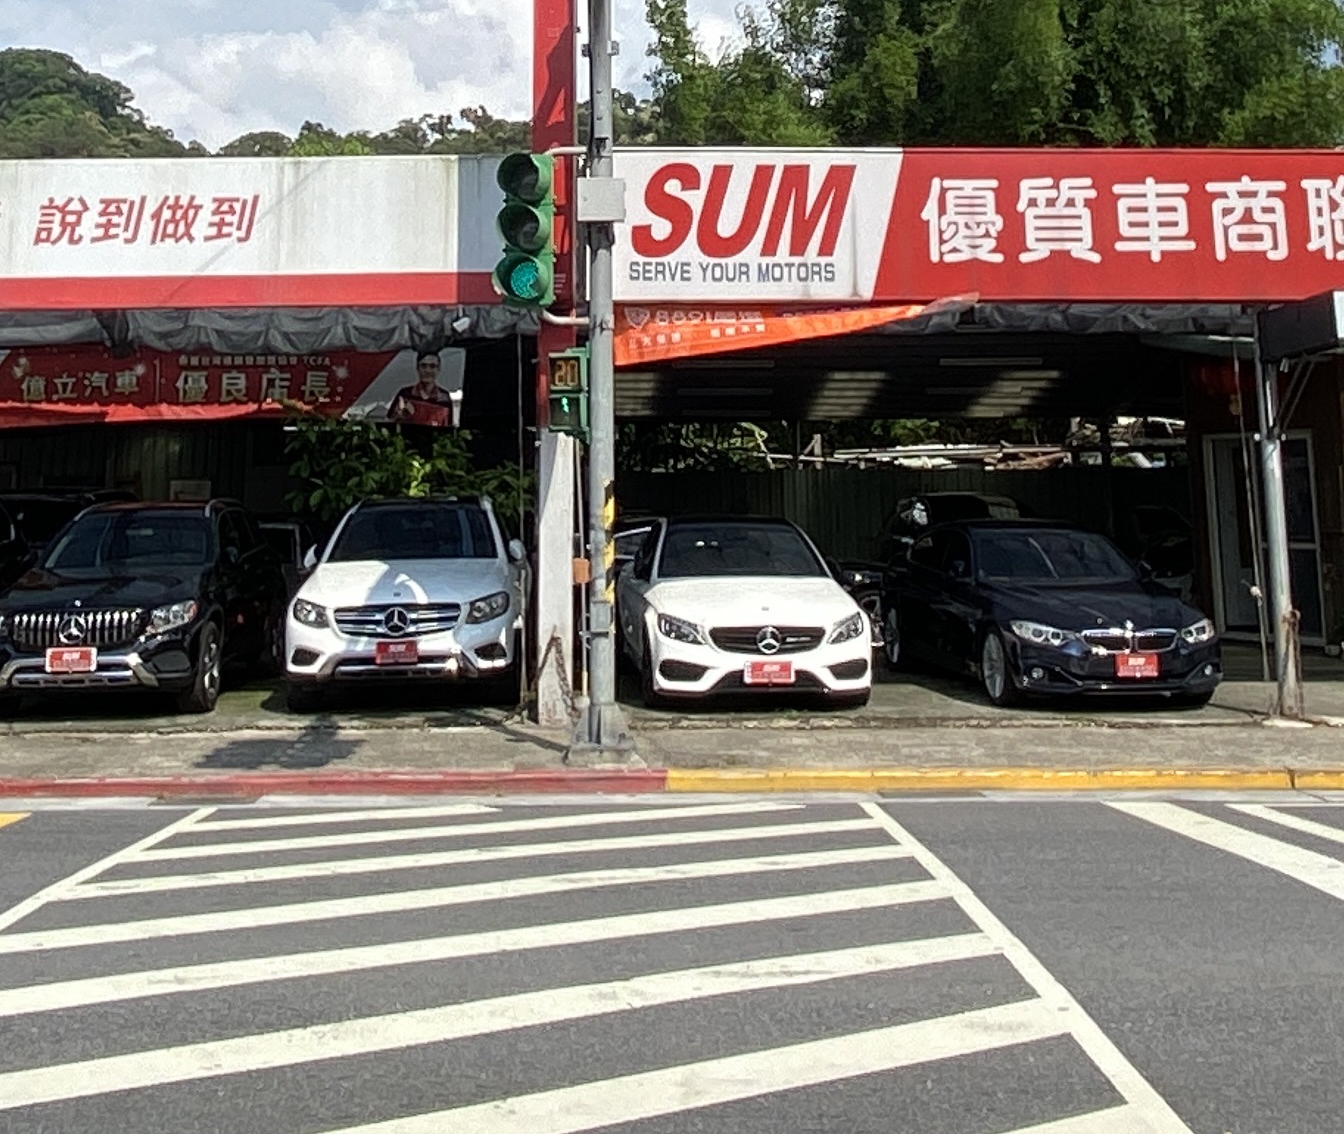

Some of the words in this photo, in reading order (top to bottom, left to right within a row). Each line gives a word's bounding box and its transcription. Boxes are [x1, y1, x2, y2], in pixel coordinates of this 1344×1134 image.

[33, 194, 261, 246] 說到做到
[631, 162, 857, 258] SUM
[629, 261, 692, 282] SERVE
[701, 261, 750, 282] YOUR
[757, 261, 836, 282] MOTORS
[21, 370, 140, 401] 億立汽車
[175, 368, 331, 403] 優良店長
[554, 360, 578, 386] 20
